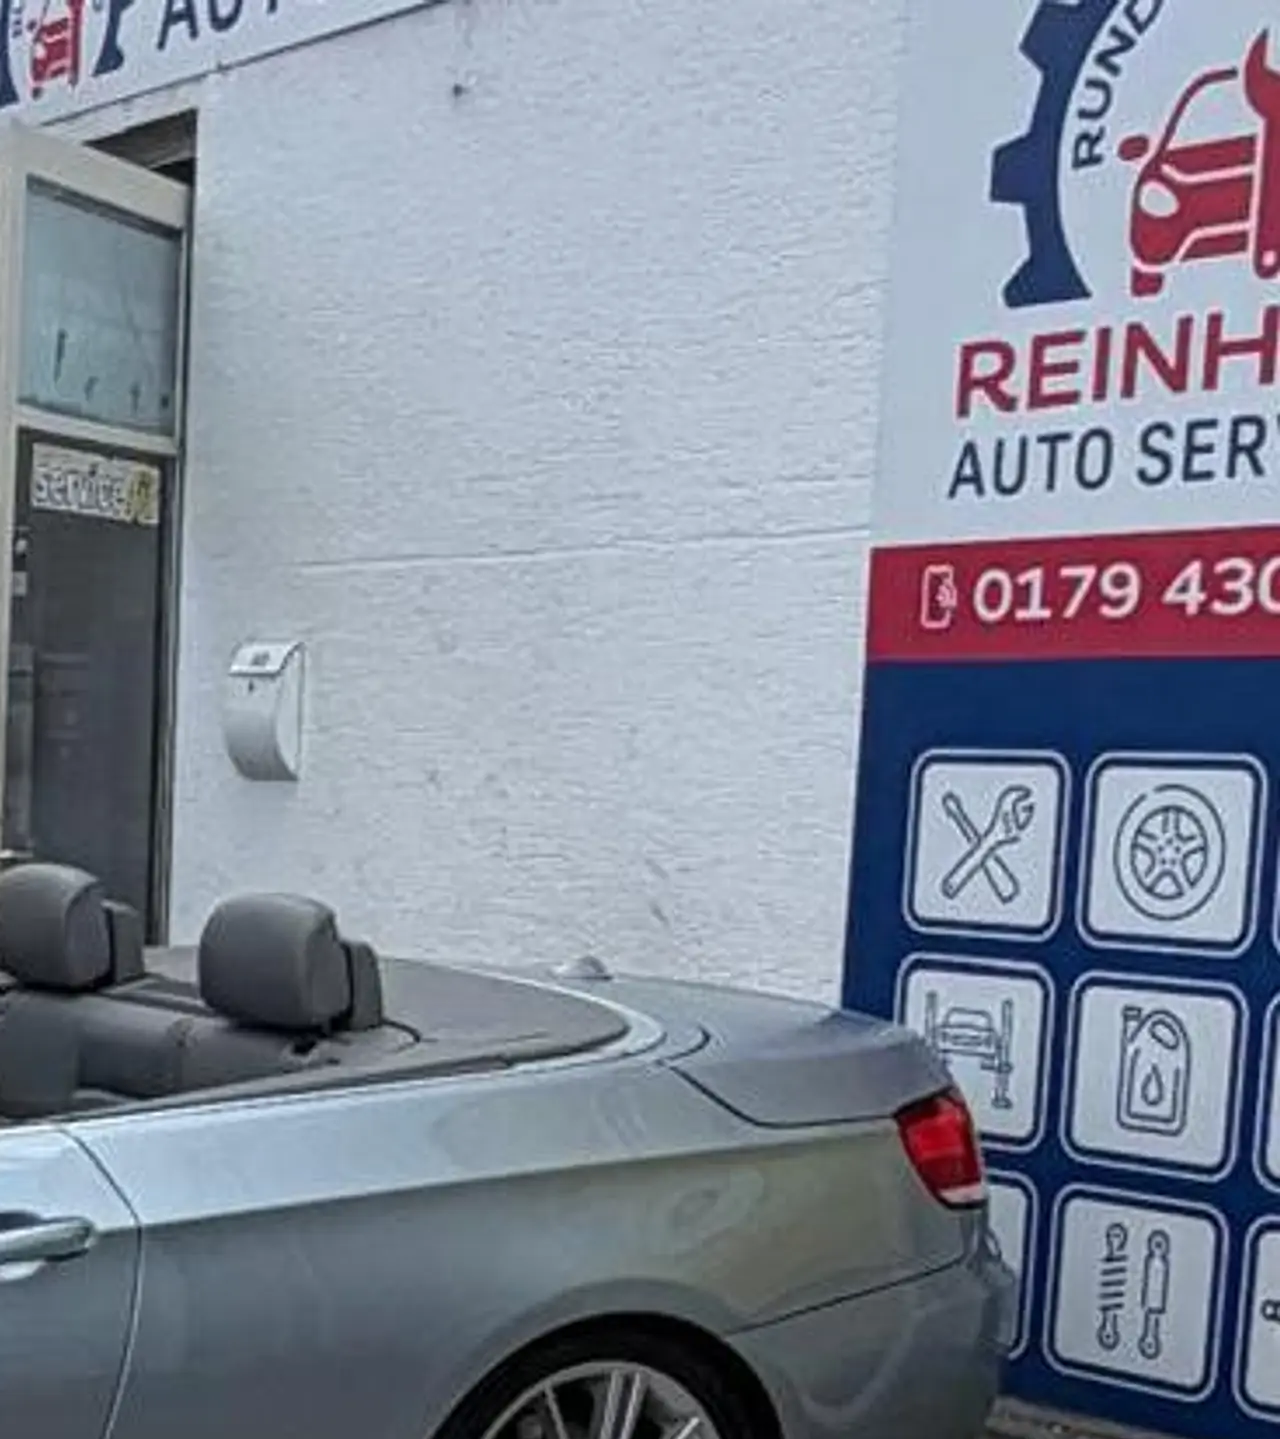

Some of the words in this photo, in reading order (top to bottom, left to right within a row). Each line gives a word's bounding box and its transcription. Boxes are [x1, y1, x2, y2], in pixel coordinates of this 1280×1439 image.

[947, 428, 1114, 500] AUTO
[1136, 414, 1280, 486] SER
[972, 561, 1140, 623] 0179
